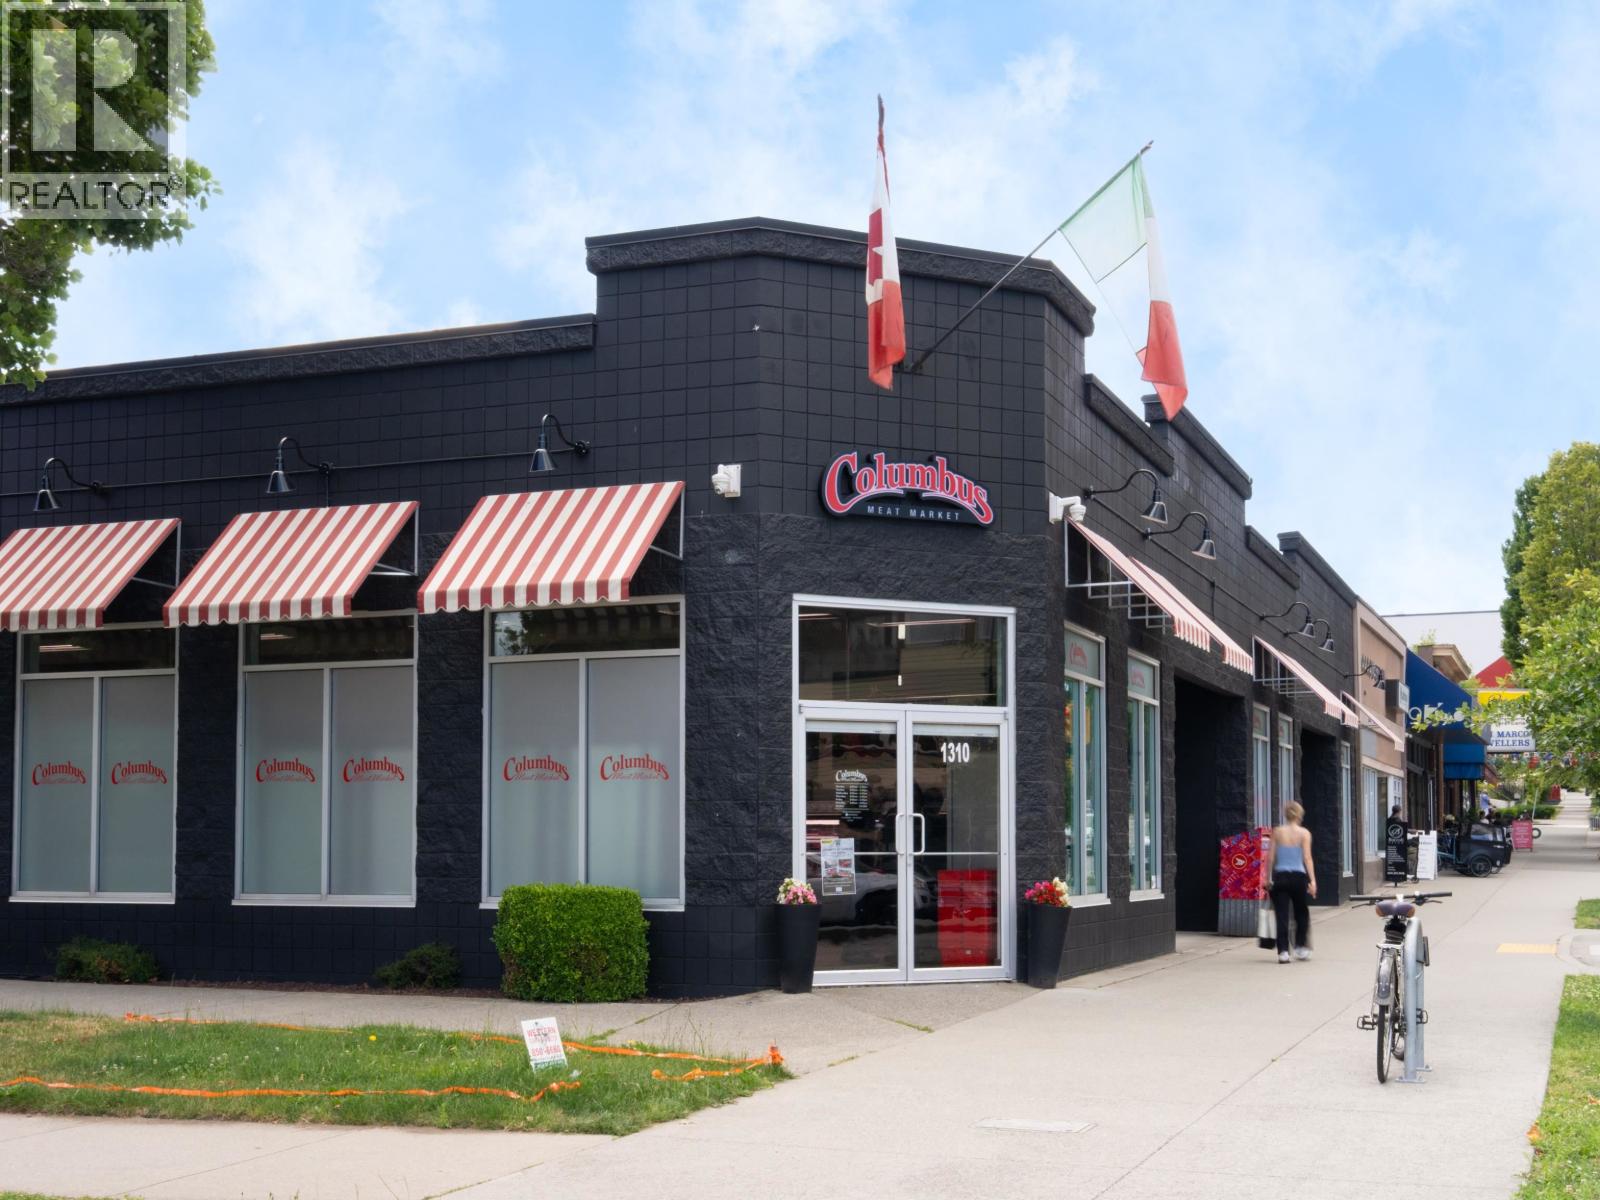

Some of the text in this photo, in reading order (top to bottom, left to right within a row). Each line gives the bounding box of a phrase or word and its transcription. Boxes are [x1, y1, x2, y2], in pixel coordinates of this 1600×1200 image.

[825, 451, 994, 525] Columbus
[867, 505, 960, 521] MEAT MARKET
[1496, 730, 1530, 738] MARCO
[941, 742, 970, 763] 1310
[32, 761, 86, 785] Columbus
[111, 760, 167, 784] Columbus
[256, 758, 315, 782] Columbus
[343, 757, 404, 782] Columbus
[503, 755, 569, 781] Columbus
[600, 753, 669, 780] Columbus
